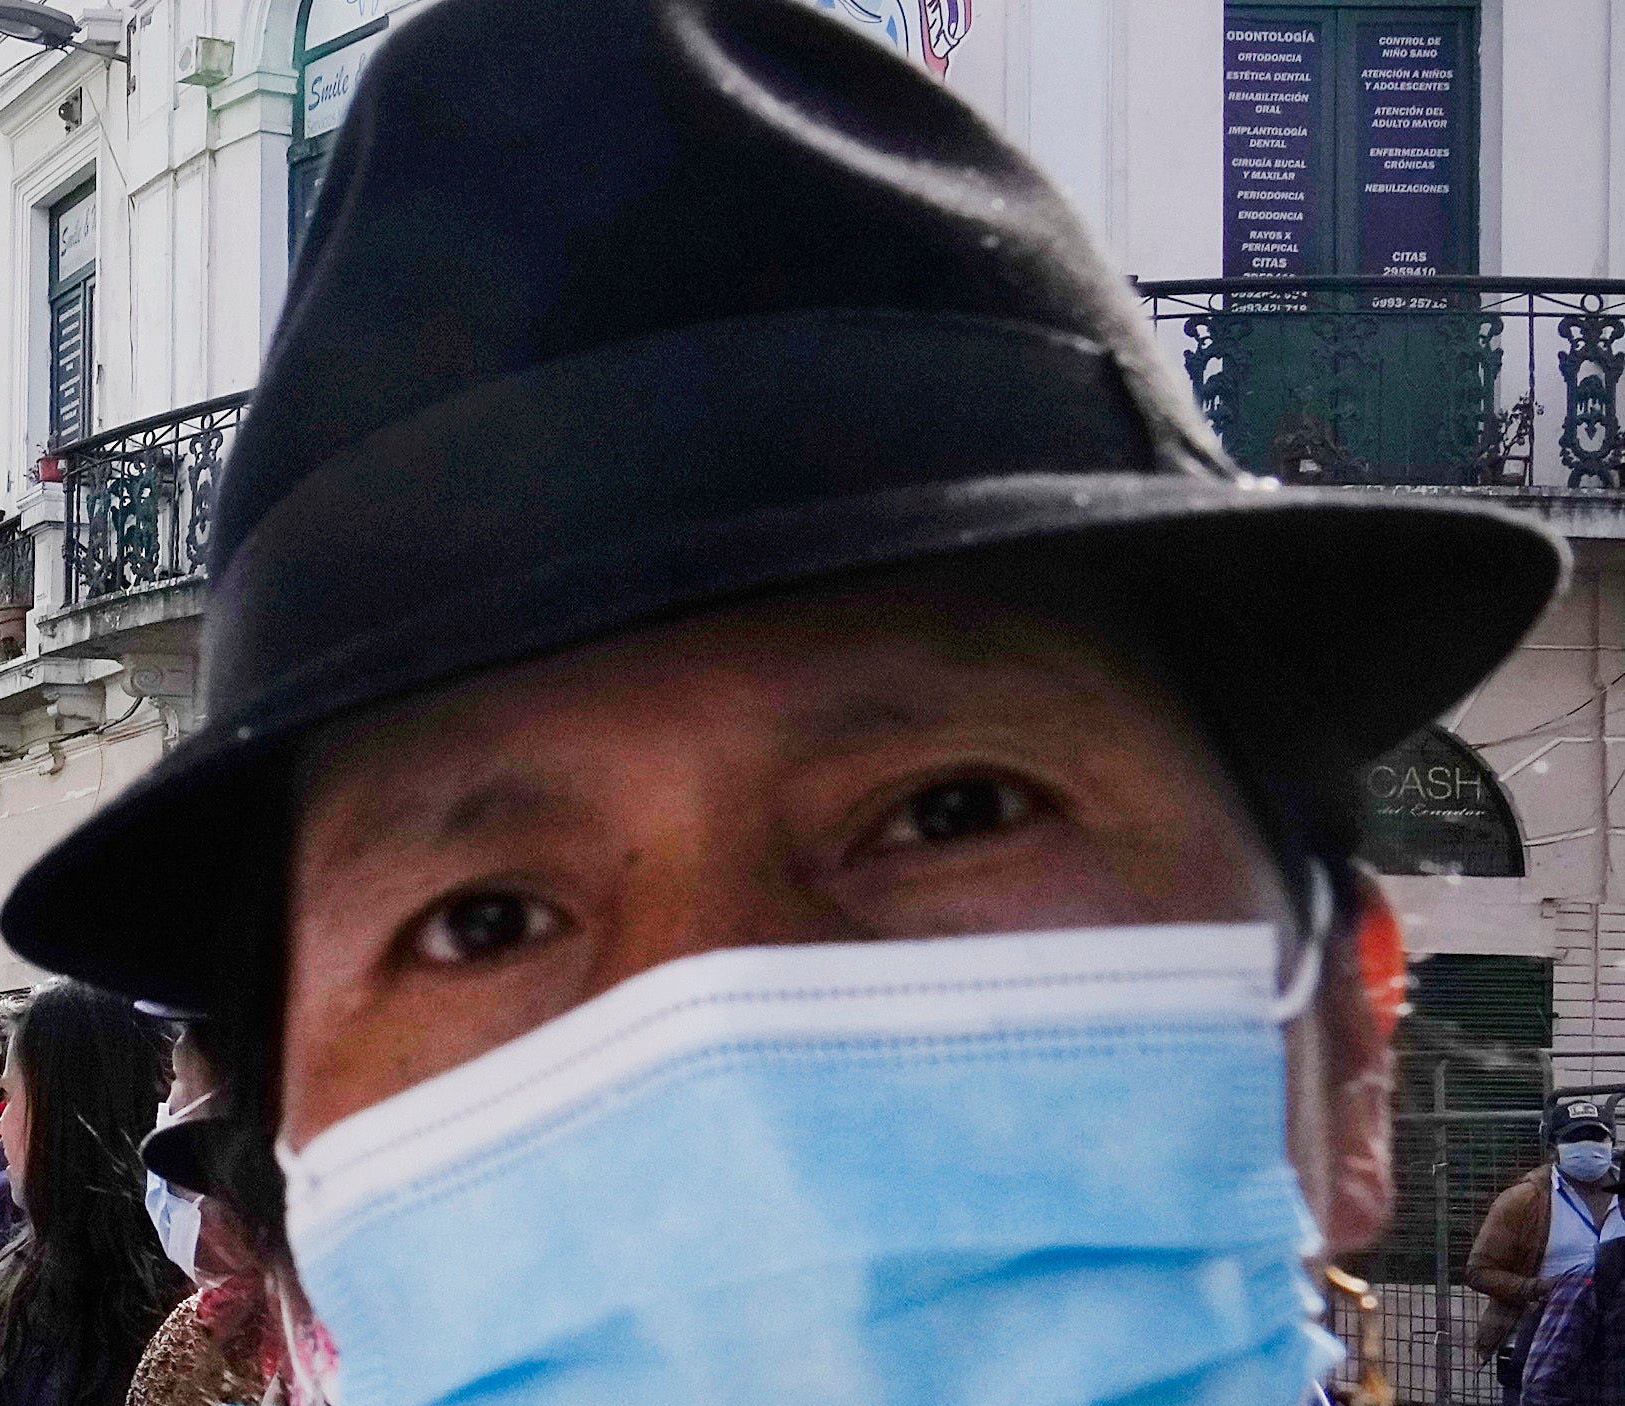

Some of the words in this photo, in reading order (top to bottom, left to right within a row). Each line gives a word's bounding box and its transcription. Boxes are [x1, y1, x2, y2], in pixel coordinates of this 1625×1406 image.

[1226, 29, 1315, 43] ODONTOLOGÍA
[1379, 36, 1424, 46] CONTROL
[1427, 37, 1442, 46] DE
[1238, 52, 1302, 62] ORTODONCIA
[1382, 47, 1408, 58] NIÑO
[1410, 49, 1438, 58] SANO
[1226, 70, 1272, 81] ESTÉTICA
[1274, 72, 1312, 82] DENTAL
[1361, 68, 1410, 78] ATENCIÓN
[1412, 70, 1420, 78] A
[1421, 68, 1453, 79] NIÑOS
[1364, 82, 1371, 91] Y
[1373, 82, 1450, 91] ADOLESCENTES
[1228, 91, 1309, 103] REHABILITACIÓN
[1255, 105, 1282, 114] ORAL
[1374, 105, 1423, 116] ATENCIÓN
[1425, 107, 1445, 116] DEL
[1371, 119, 1409, 128] ADULTO
[1412, 119, 1448, 129] MAYOR
[1228, 126, 1308, 137] IMPLANTOLOGÍA
[1249, 139, 1287, 148] DENTAL
[1369, 148, 1450, 157] ENFERMEDADES
[1231, 157, 1272, 167] CIRUGÍA
[1274, 159, 1307, 169] BUCAL
[1383, 159, 1435, 169] CRÓNICAS
[1243, 171, 1249, 179] Y
[1251, 171, 1296, 180] MAXILAR
[1364, 183, 1449, 193] NEBULIZACIONES
[1237, 190, 1305, 200] PERIODONCIA
[1238, 211, 1304, 221] ENDODONCIA
[1249, 231, 1282, 240] RAYOS
[1284, 232, 1292, 240] X
[1241, 243, 1299, 253] PERIAPICAL
[1392, 251, 1427, 262] CITAS
[1252, 257, 1287, 268] CITAS
[1367, 765, 1482, 800] CASH
